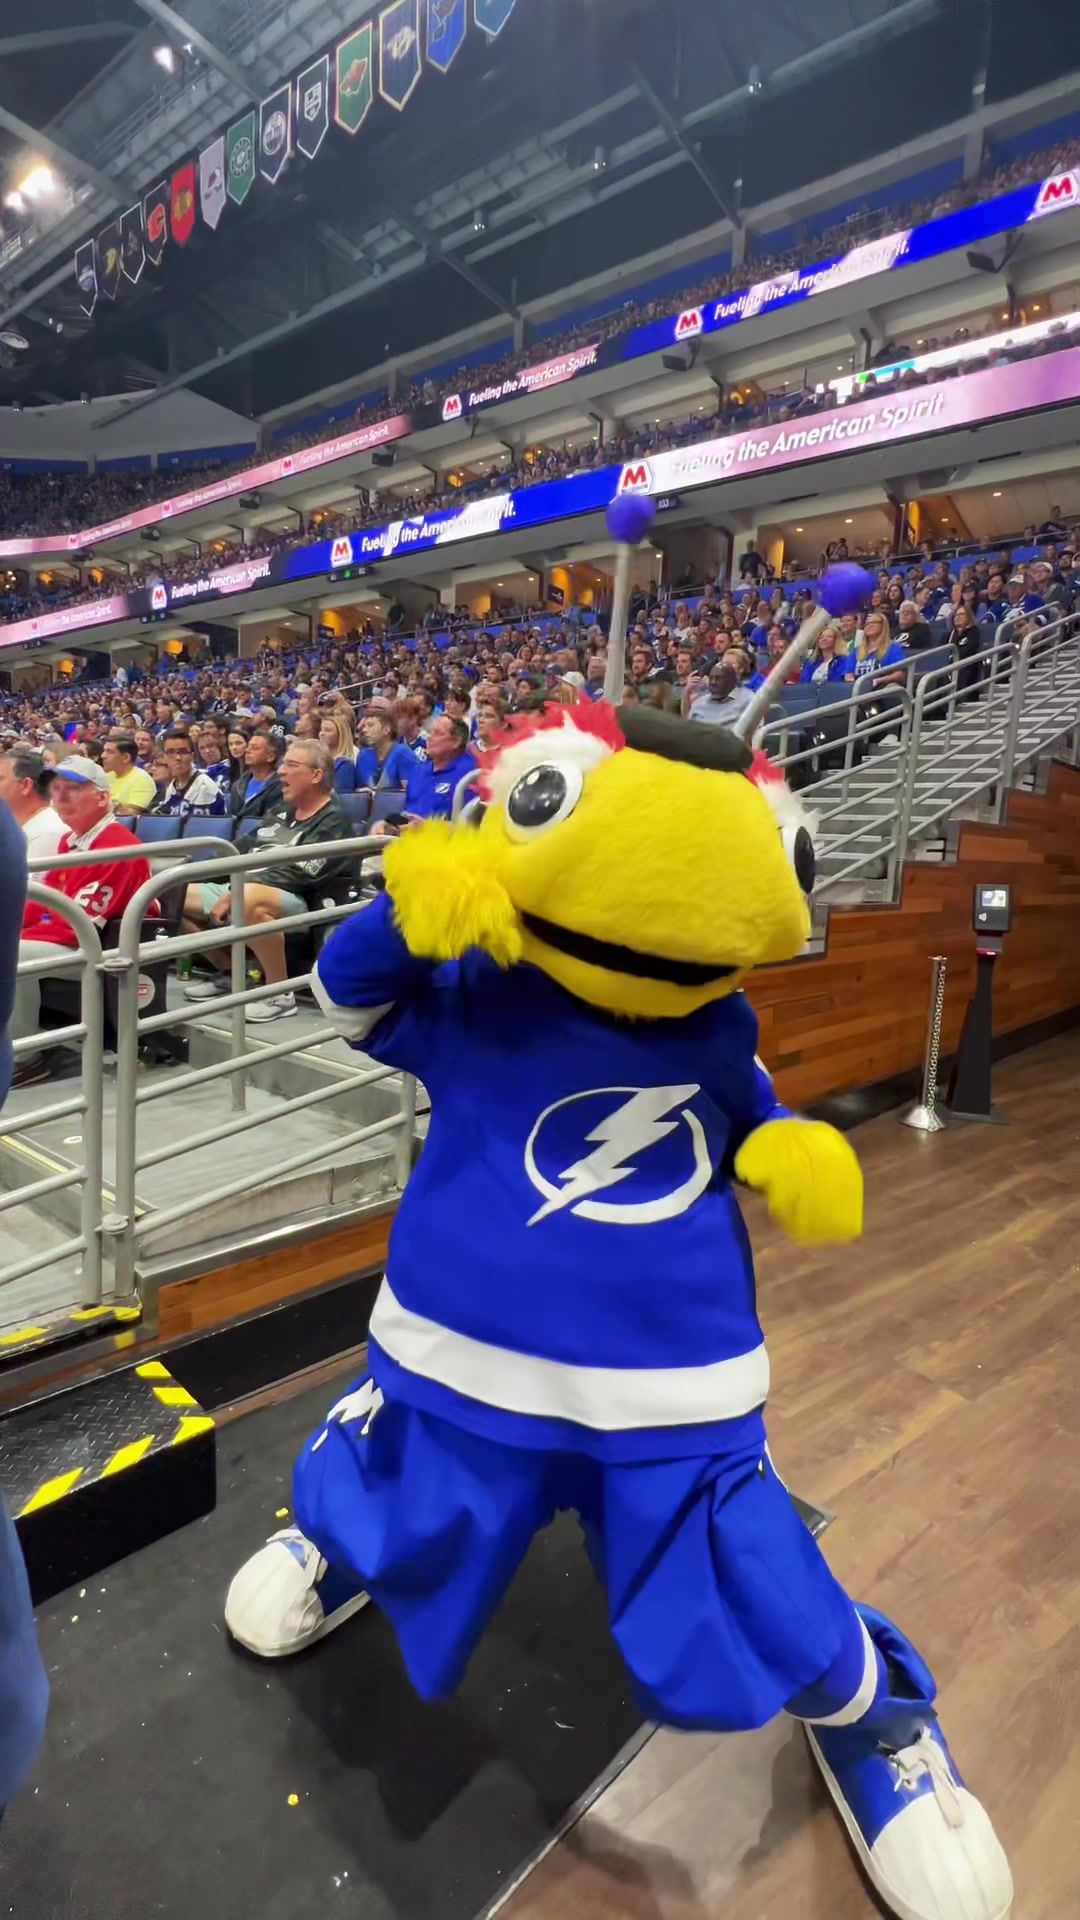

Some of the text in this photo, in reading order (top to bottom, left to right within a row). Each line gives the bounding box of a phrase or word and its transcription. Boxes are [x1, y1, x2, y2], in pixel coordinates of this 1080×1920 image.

[765, 283, 787, 301] the
[469, 386, 501, 406] Fueling
[502, 379, 518, 394] the
[518, 364, 565, 389] American
[738, 438, 769, 462] the
[771, 413, 875, 455] American
[623, 465, 647, 488] M
[401, 524, 418, 543] the
[198, 578, 210, 592] the
[210, 570, 246, 588] American
